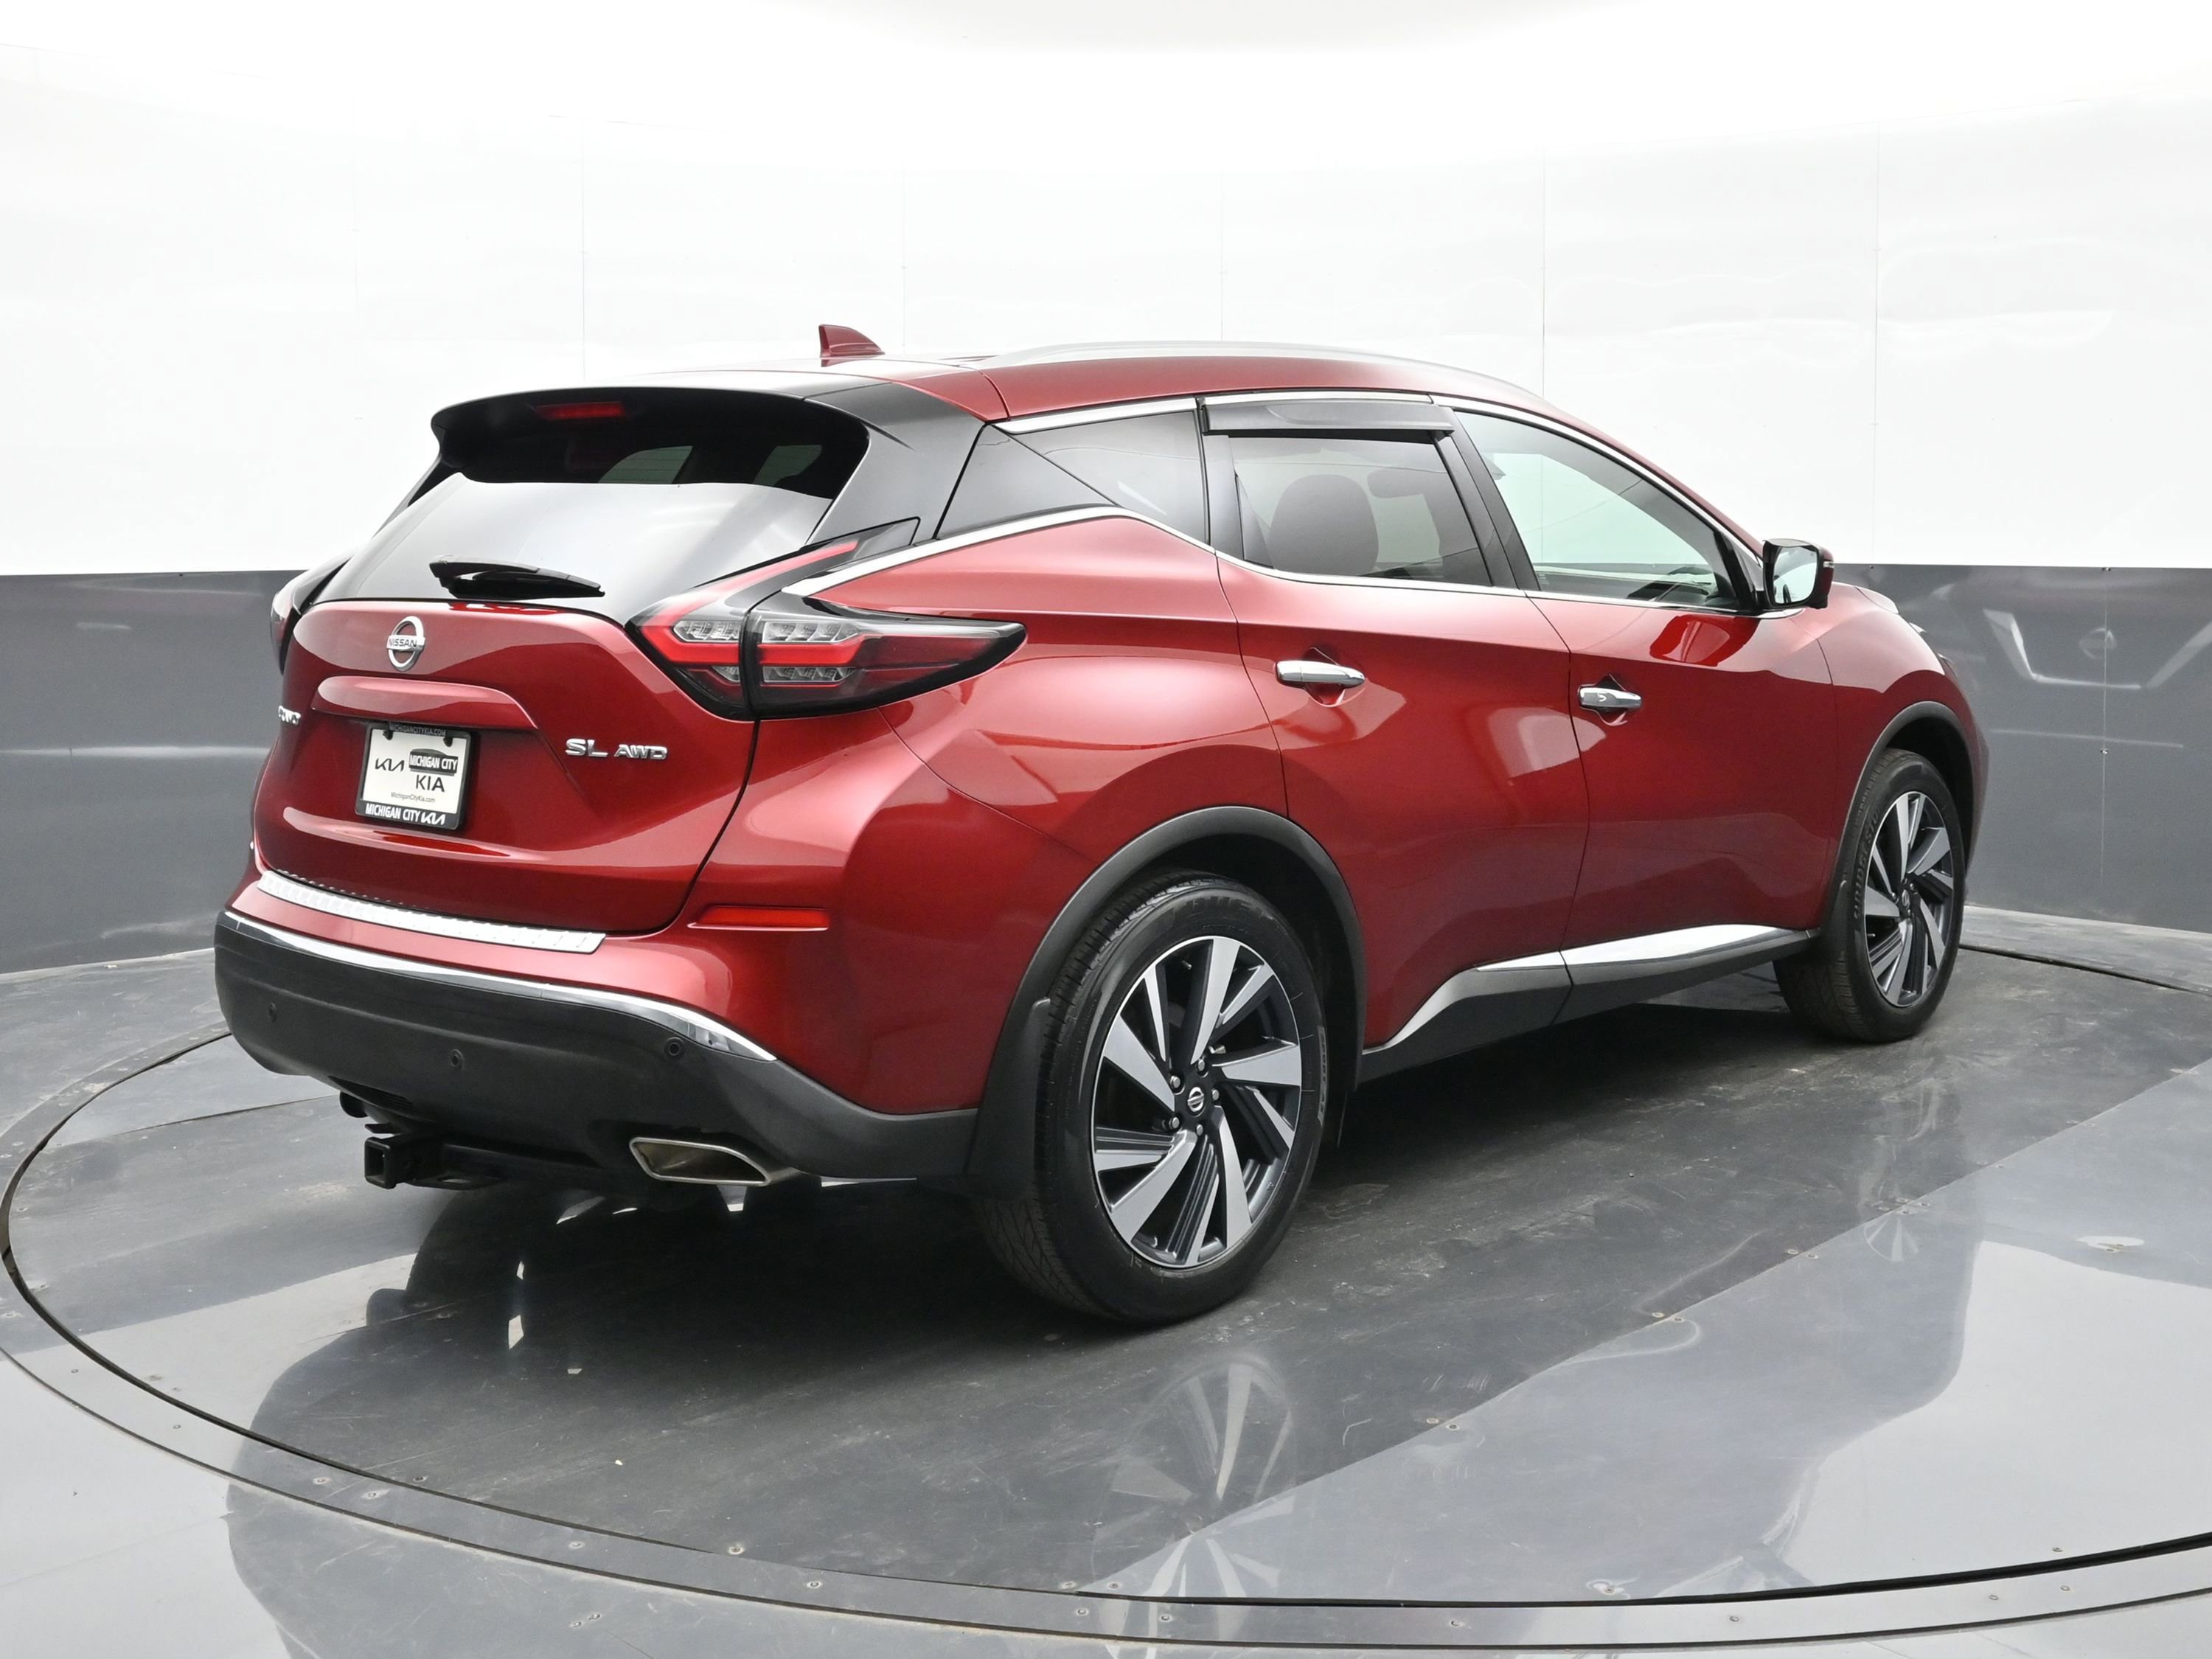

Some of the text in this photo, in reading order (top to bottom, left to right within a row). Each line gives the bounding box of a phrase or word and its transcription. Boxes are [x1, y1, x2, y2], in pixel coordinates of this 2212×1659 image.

[389, 638, 417, 647] NISSAN
[565, 738, 668, 760] SL AWD
[410, 754, 459, 771] MICHIGAN CITY
[416, 774, 445, 793] KIA
[366, 803, 401, 819] MICHIGAN
[403, 808, 421, 822] CITY
